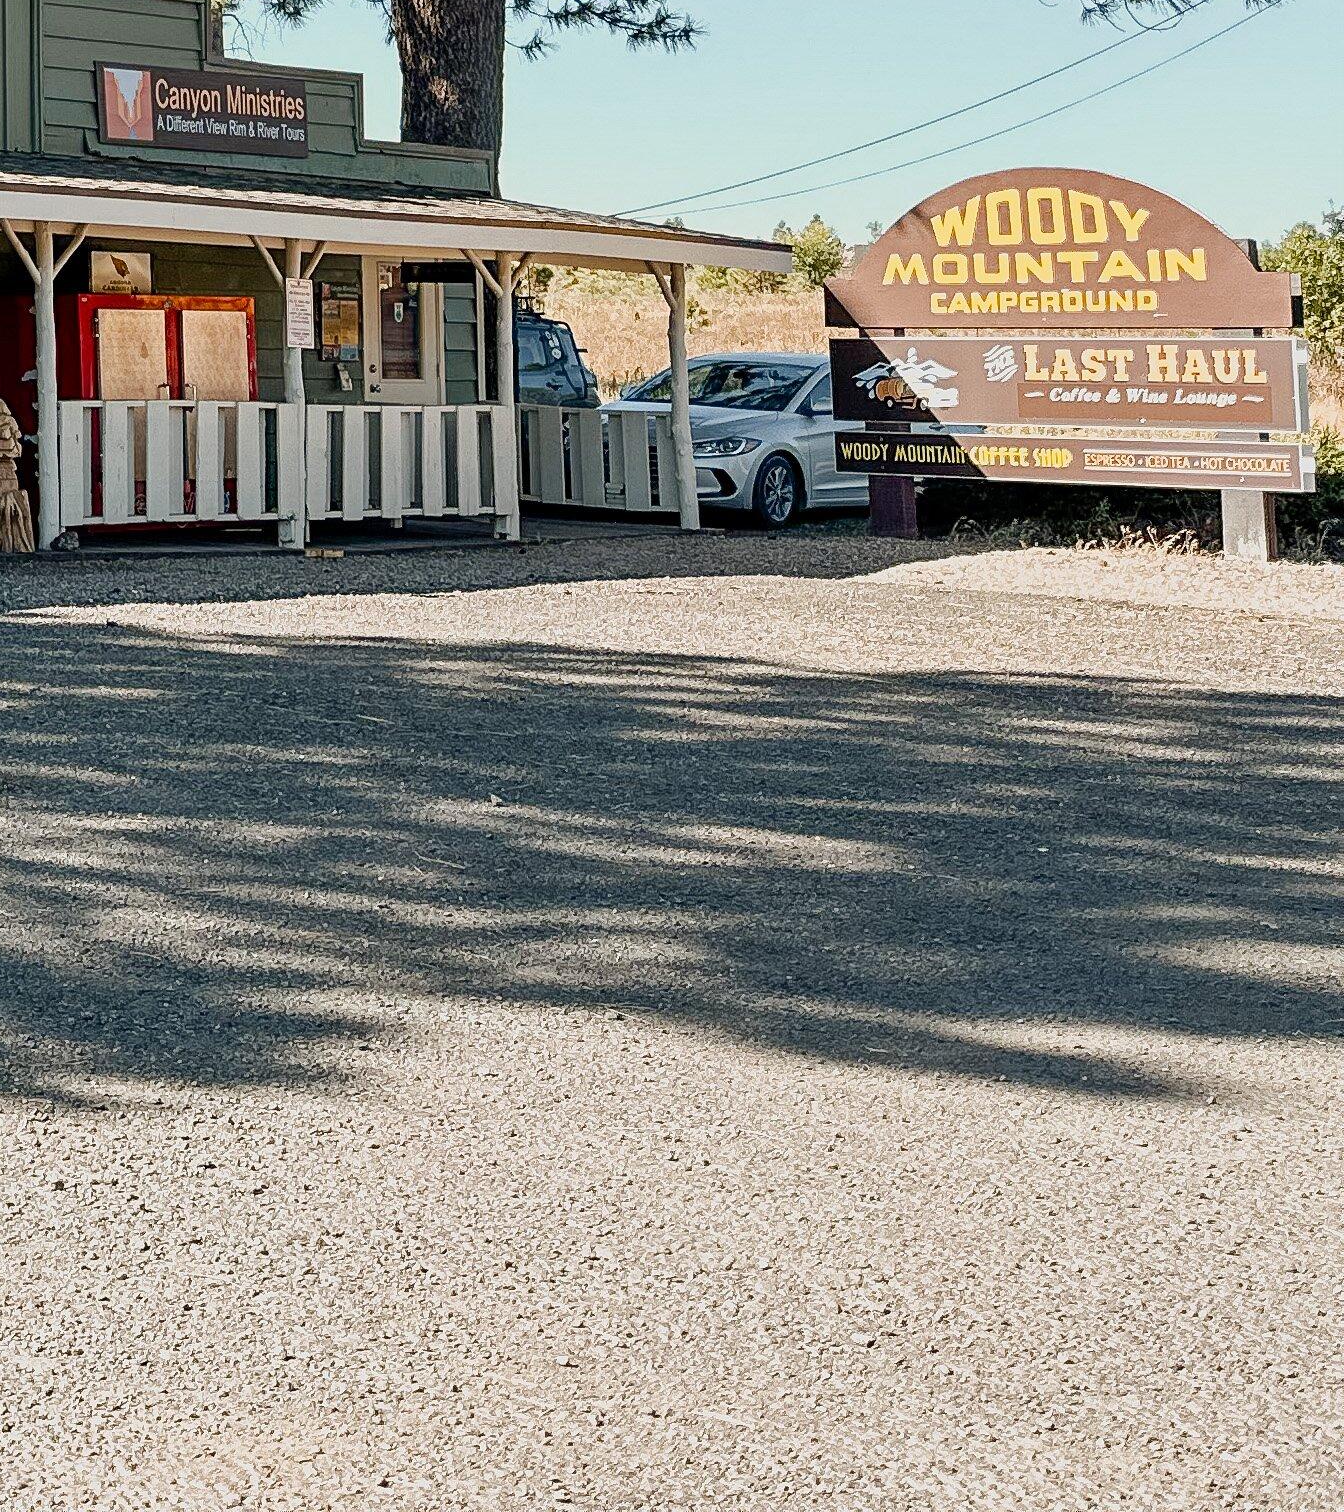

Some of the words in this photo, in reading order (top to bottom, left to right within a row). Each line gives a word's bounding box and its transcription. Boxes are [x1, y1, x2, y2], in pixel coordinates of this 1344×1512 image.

[155, 78, 221, 118] Canyon
[227, 84, 305, 120] Ministries
[157, 114, 165, 131] A
[167, 115, 204, 134] Different
[205, 118, 227, 135] View
[229, 120, 247, 137] Rim
[249, 121, 255, 138] &
[257, 121, 279, 139] River
[281, 124, 304, 141] Tours
[930, 187, 1151, 247] WOODY
[881, 248, 1207, 286] MOUNTAIN
[930, 289, 1159, 315] CAMPGROUND
[1023, 344, 1134, 383] LAST
[1146, 344, 1268, 384] HAUL
[1049, 388, 1101, 404] Coffee
[1105, 388, 1120, 403] &
[1126, 388, 1168, 405] Wine
[1173, 389, 1237, 408] Lounge
[840, 442, 889, 462] WOODY
[894, 444, 967, 464] MOUNTAIN
[969, 446, 1030, 467] COFFEE
[1033, 447, 1074, 469] SHOP
[1084, 453, 1135, 467] ESPRESSO
[1145, 455, 1168, 468] ICED
[1169, 456, 1191, 469] TEA
[1201, 457, 1224, 471] HOT
[1226, 458, 1291, 472] CHOCOLATE
